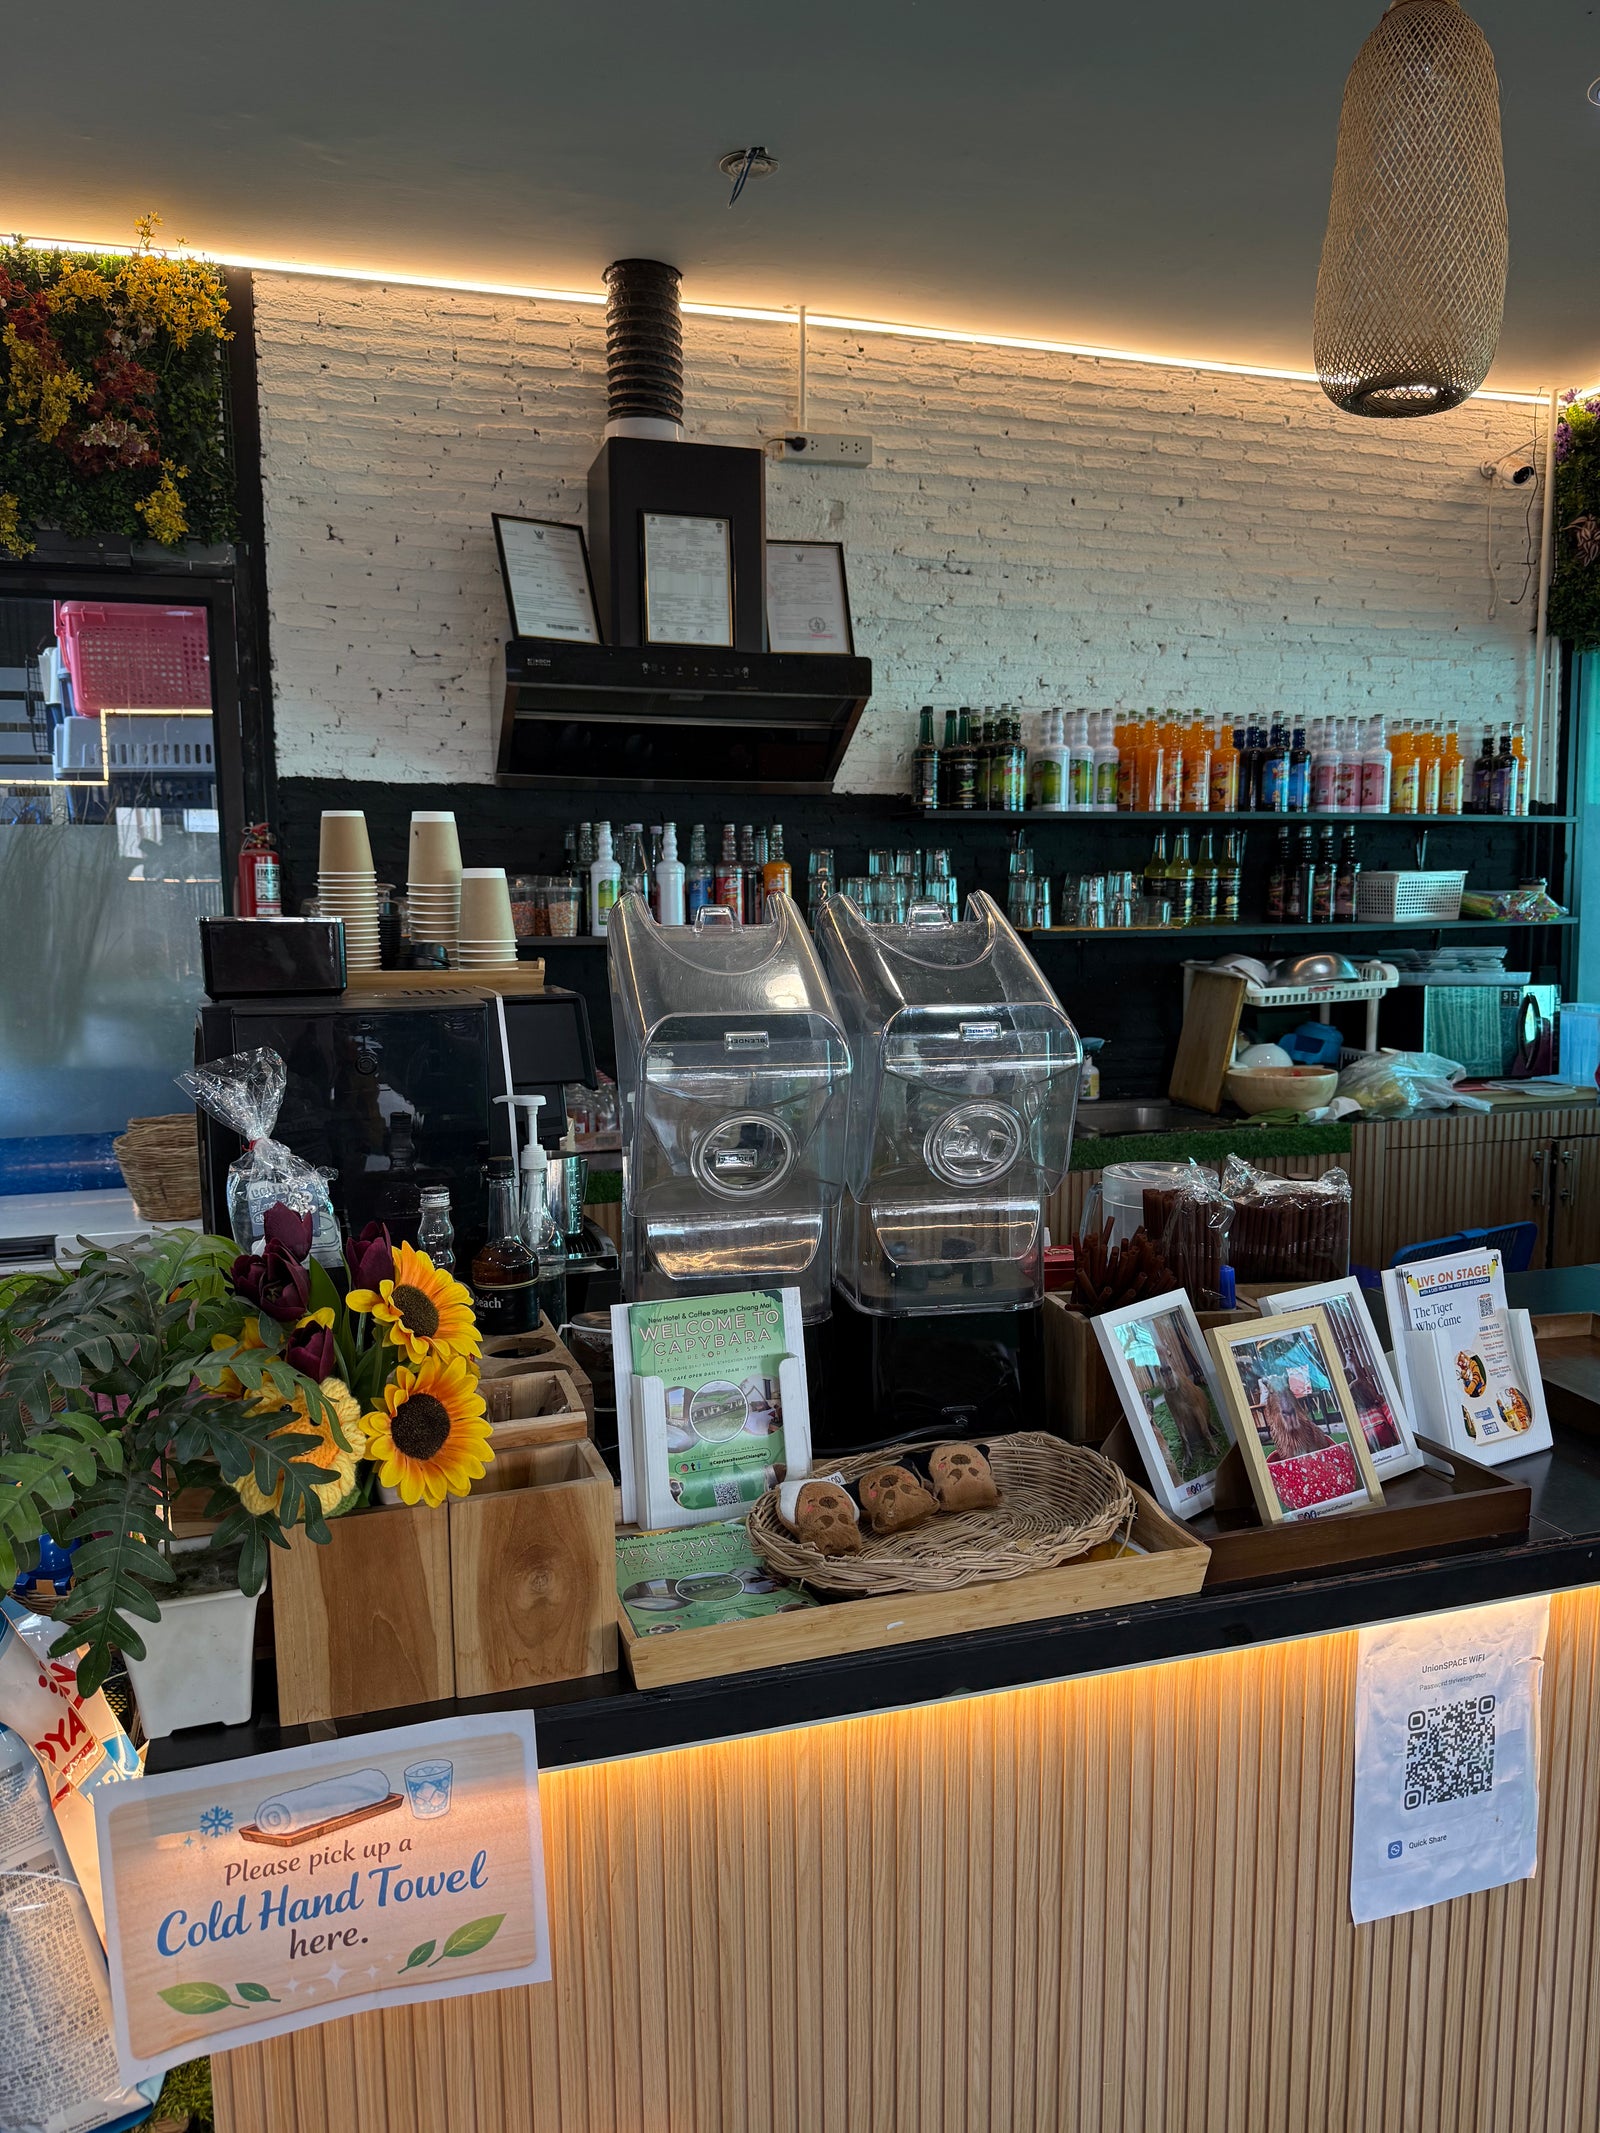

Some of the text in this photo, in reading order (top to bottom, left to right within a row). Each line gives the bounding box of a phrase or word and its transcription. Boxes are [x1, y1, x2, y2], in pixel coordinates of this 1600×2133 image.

[1416, 1264, 1490, 1288] LIVE ON STAGE!
[648, 1317, 662, 1325] New
[663, 1313, 681, 1322] Hotel
[712, 1308, 728, 1316] Shop
[736, 1304, 759, 1313] Chiang
[1413, 1302, 1453, 1319] The Tiger
[639, 1310, 780, 1342] WELCOME TO
[1416, 1315, 1462, 1332] Who Came
[653, 1328, 772, 1357] CAPYBARA
[687, 1350, 728, 1360] RESORT
[1421, 1657, 1468, 1673] UnionSPACE
[1419, 1680, 1448, 1691] Password
[1409, 1834, 1447, 1849] Quick Share
[224, 1835, 413, 1885] Please pick up a
[157, 1849, 489, 1958] Cold Hand Towel
[289, 1926, 369, 1960] here.
